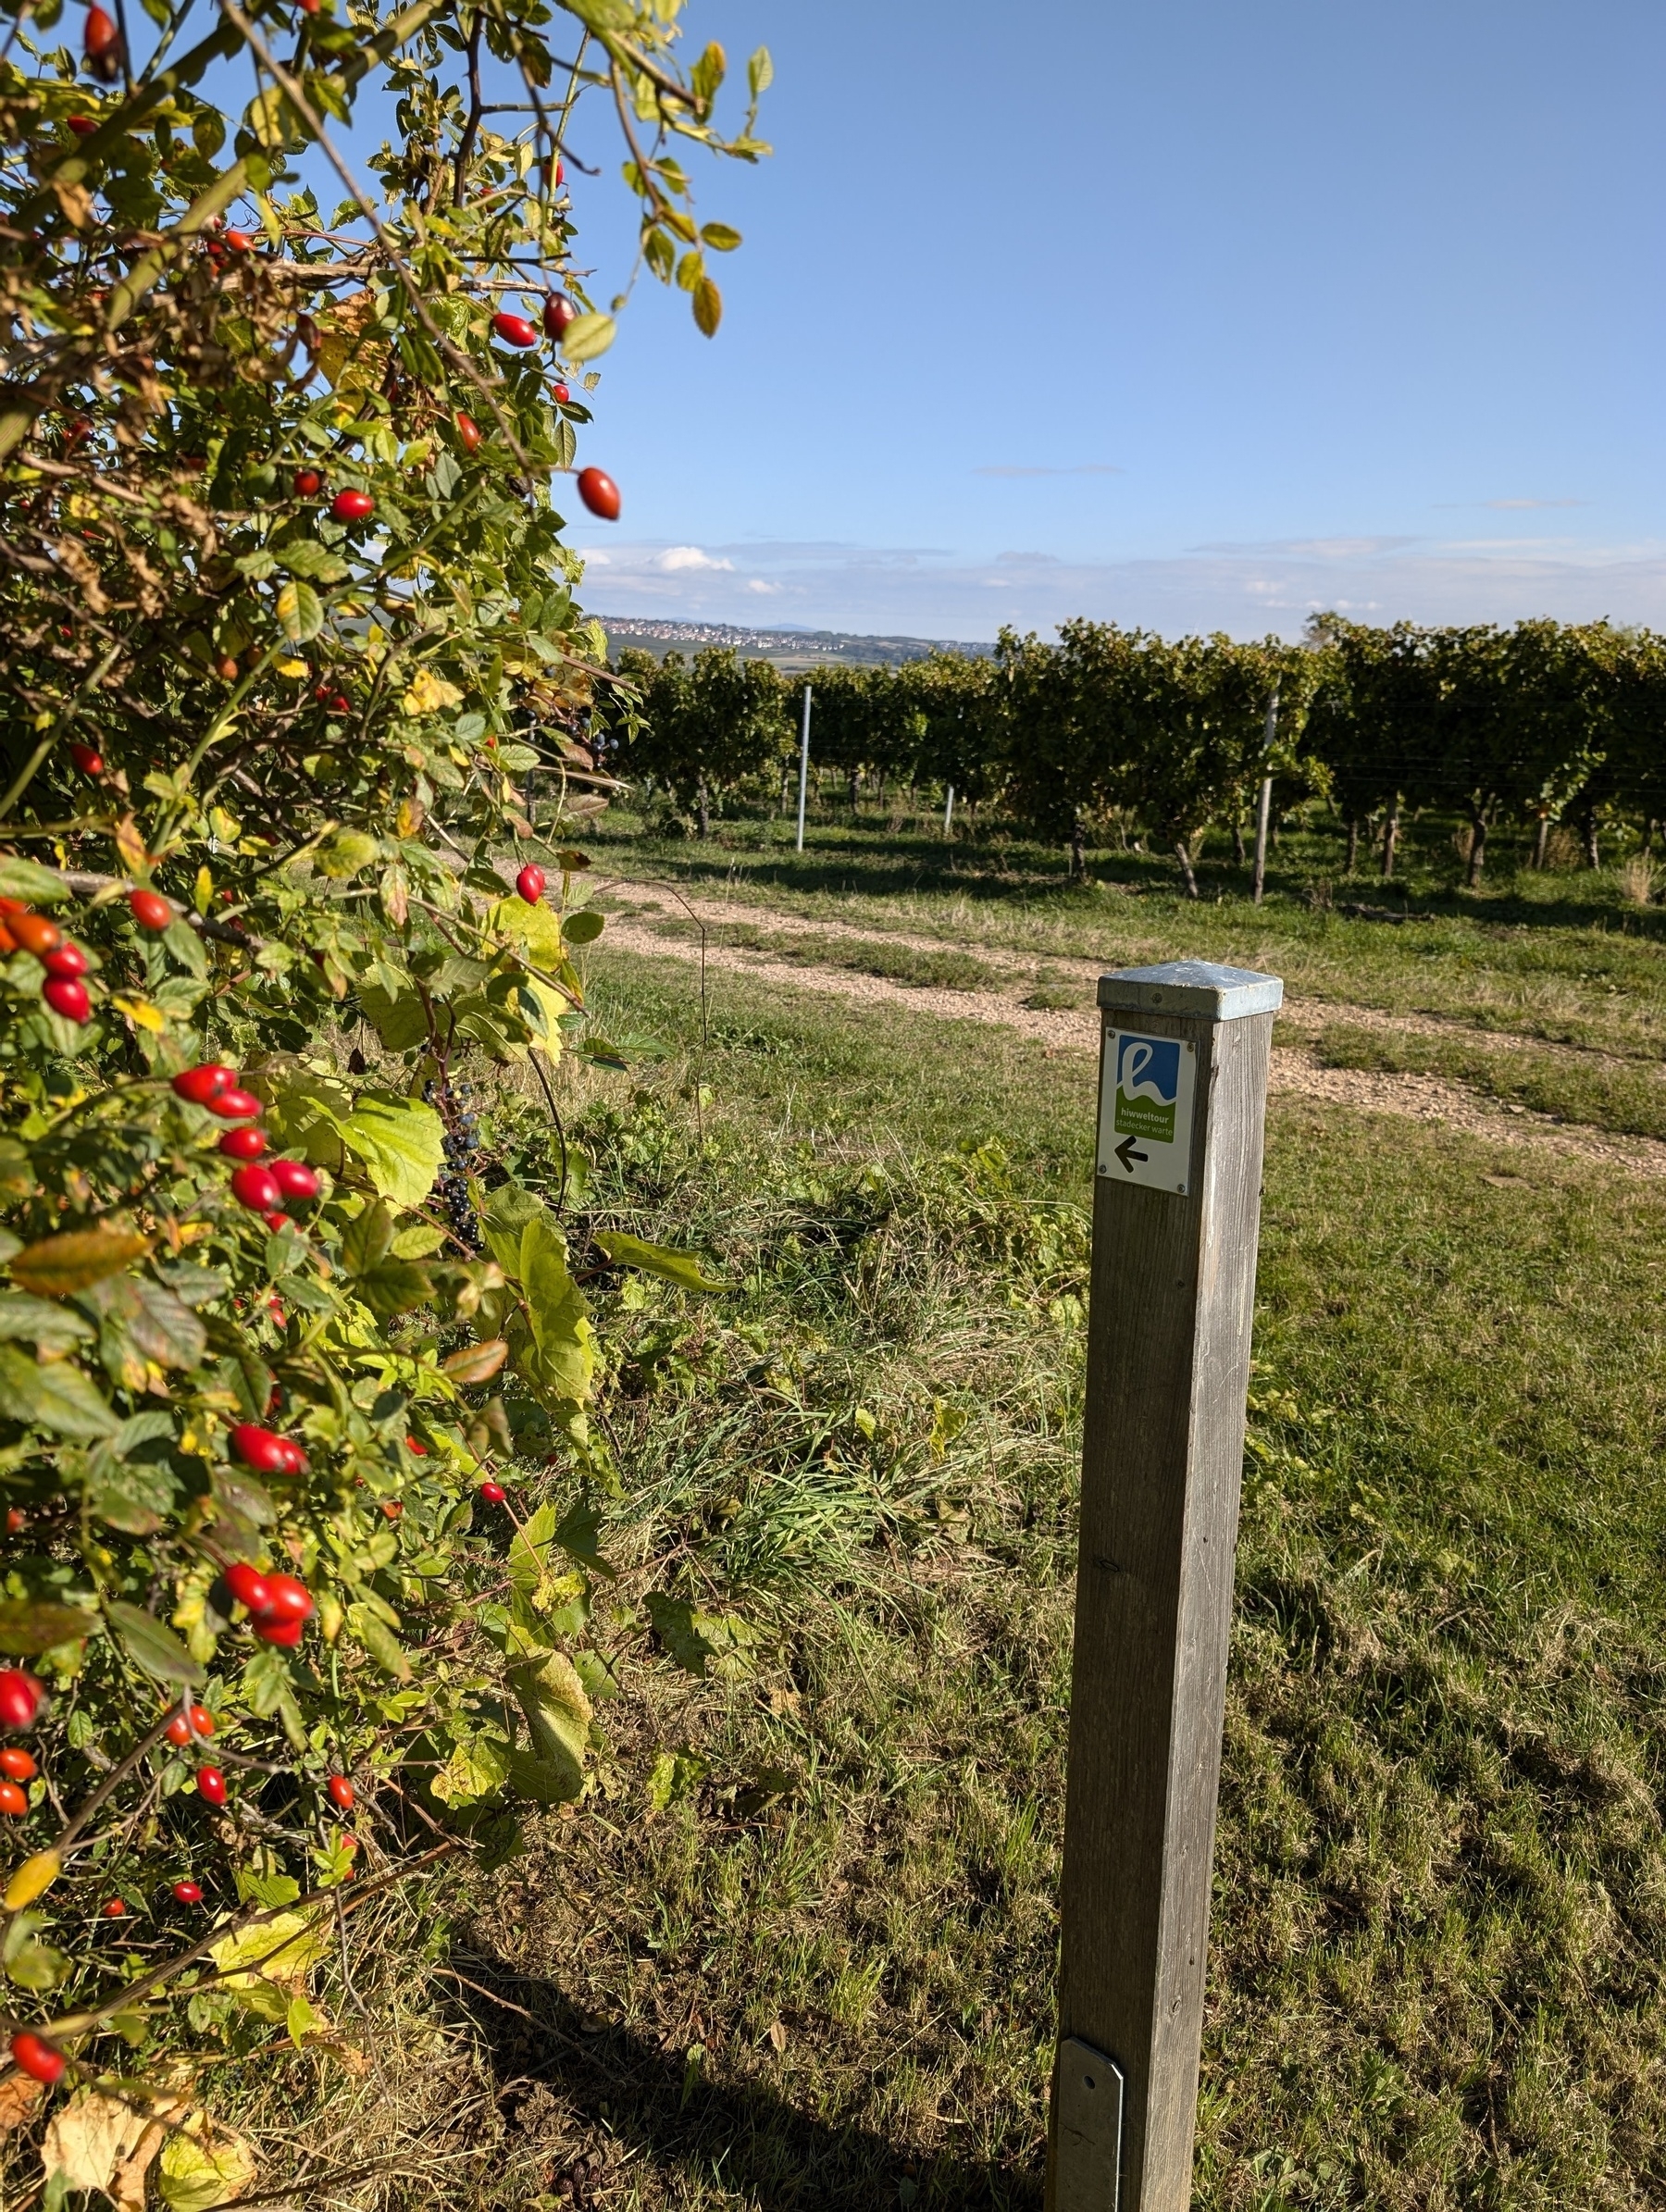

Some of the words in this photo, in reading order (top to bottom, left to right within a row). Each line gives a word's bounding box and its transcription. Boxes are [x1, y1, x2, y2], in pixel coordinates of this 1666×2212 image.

[1121, 1107, 1169, 1124] hiwweltour
[1116, 1119, 1150, 1132] stadecker
[1151, 1126, 1173, 1137] warte
